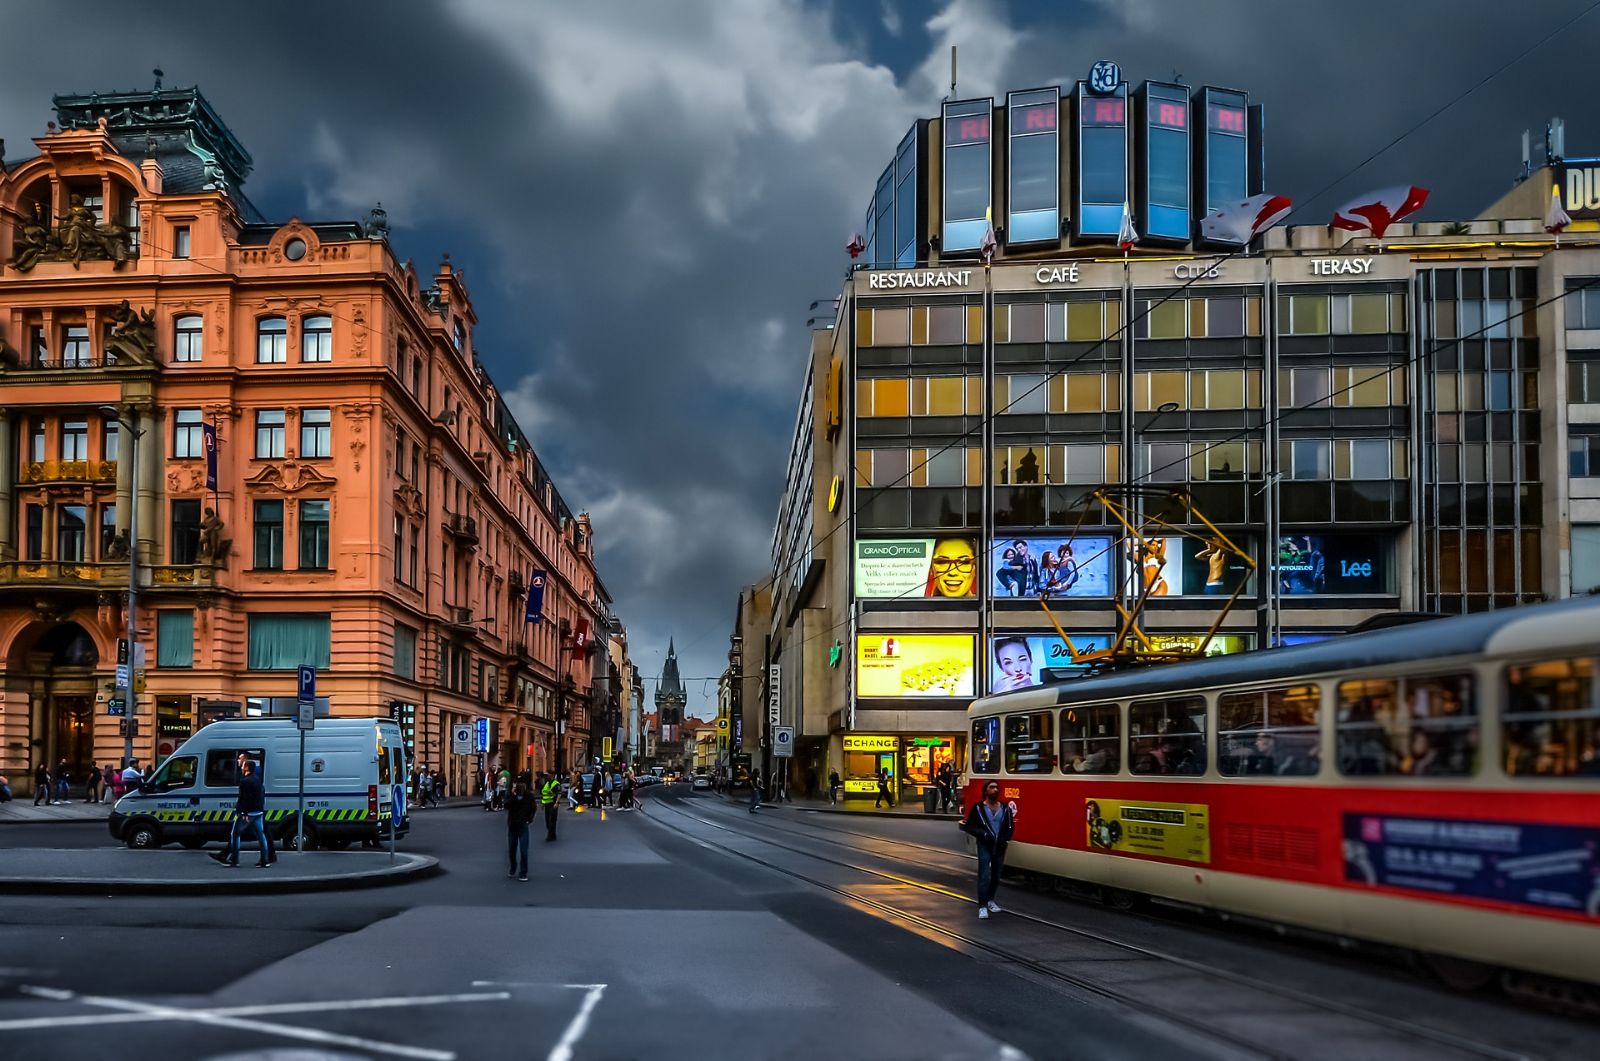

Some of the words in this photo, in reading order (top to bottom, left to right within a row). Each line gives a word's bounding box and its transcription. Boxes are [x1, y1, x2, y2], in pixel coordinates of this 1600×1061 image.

[1035, 262, 1079, 284] CAFÉ
[1174, 263, 1219, 280] CLUB
[1311, 258, 1373, 276] TERASY
[869, 270, 971, 289] RESTAURANT
[1340, 559, 1372, 577] Lee
[302, 669, 312, 691] P
[853, 739, 898, 747] CHANGE
